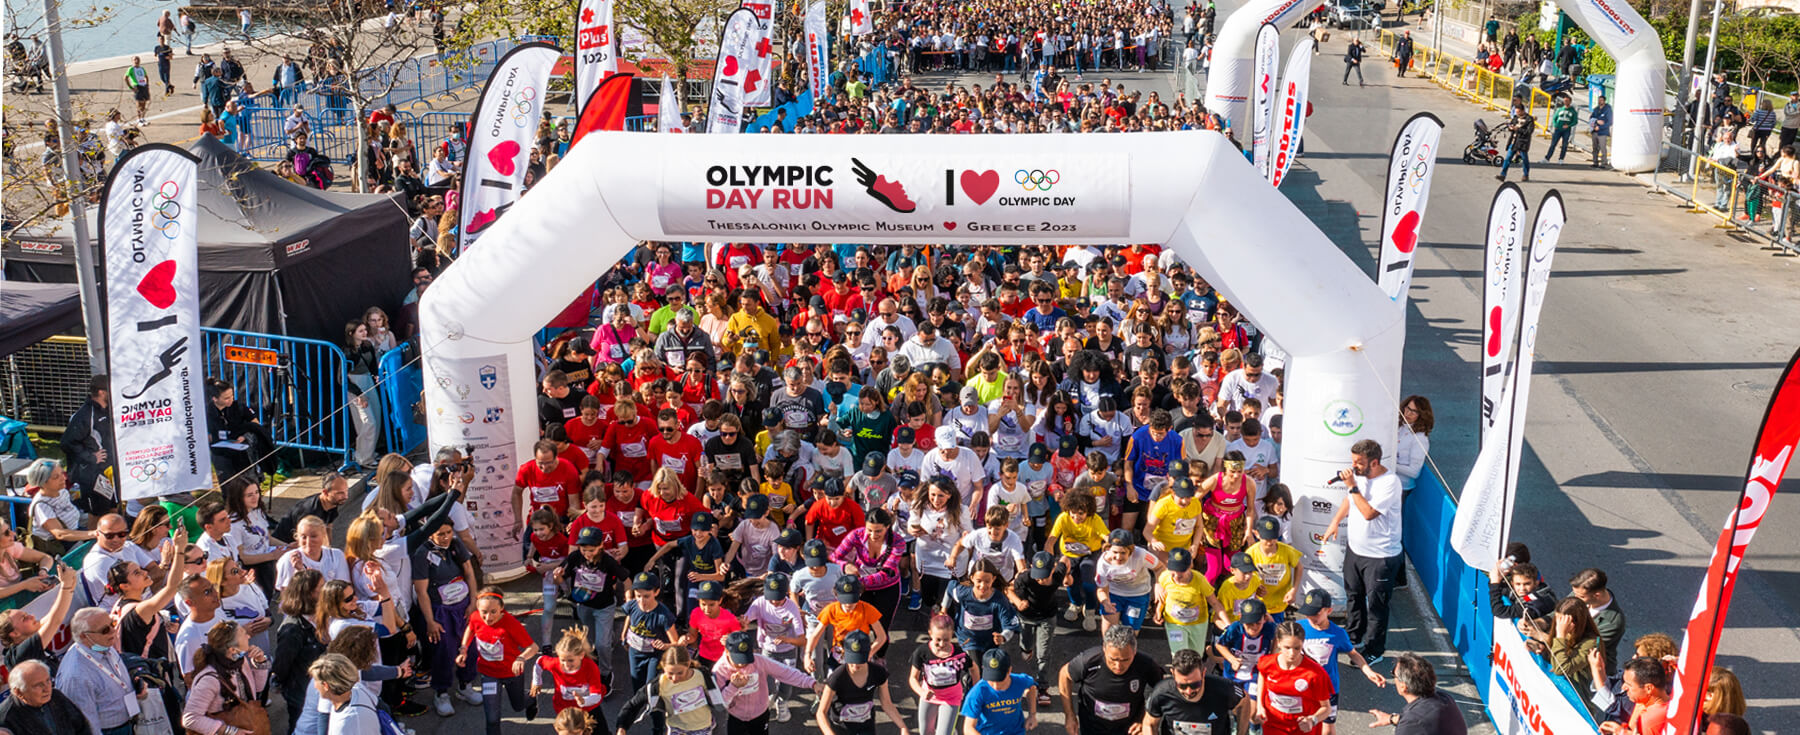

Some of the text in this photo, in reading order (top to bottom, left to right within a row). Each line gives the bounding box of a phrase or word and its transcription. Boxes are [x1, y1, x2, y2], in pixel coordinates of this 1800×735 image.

[580, 31, 607, 46] Plus
[706, 165, 834, 187] OLYMPIC
[946, 169, 955, 206] I
[706, 188, 834, 210] DAY RUN
[999, 197, 1076, 206] OLYMPIC DAY
[708, 220, 1077, 232] THESSALONIKI OLYMPIC MUSEUM GREECE 2023
[1509, 203, 1518, 231] DAY
